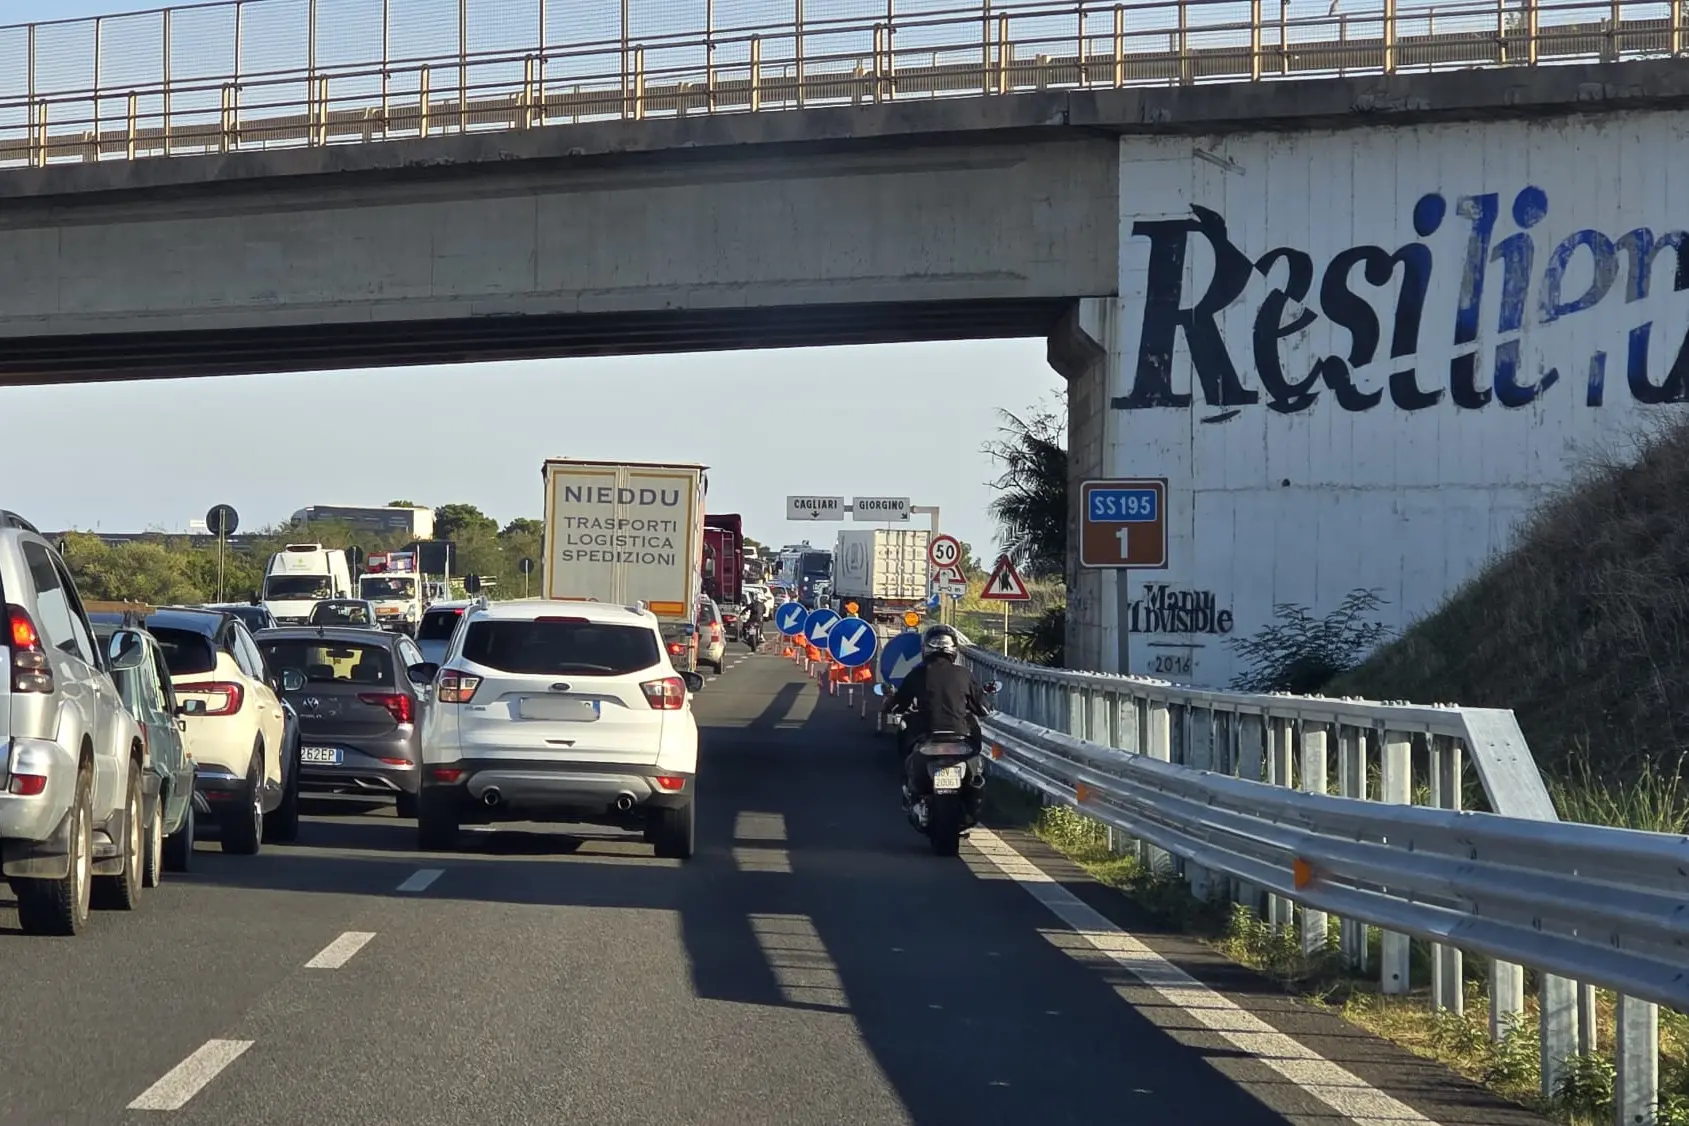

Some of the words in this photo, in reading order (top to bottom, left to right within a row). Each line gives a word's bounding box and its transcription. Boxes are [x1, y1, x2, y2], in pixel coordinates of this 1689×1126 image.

[564, 485, 680, 507] NIEDDU
[793, 498, 838, 510] CAGLIARI
[858, 500, 905, 511] GIORGINO
[563, 516, 677, 533] TRASPORTI
[567, 533, 674, 550] LOGISTICA
[1115, 527, 1129, 559] 1
[562, 549, 676, 566] SPEDIZIONI
[935, 544, 955, 560] 50
[1143, 584, 1210, 611] Manu
[1127, 599, 1234, 635] Invisible
[1154, 655, 1191, 673] 2016
